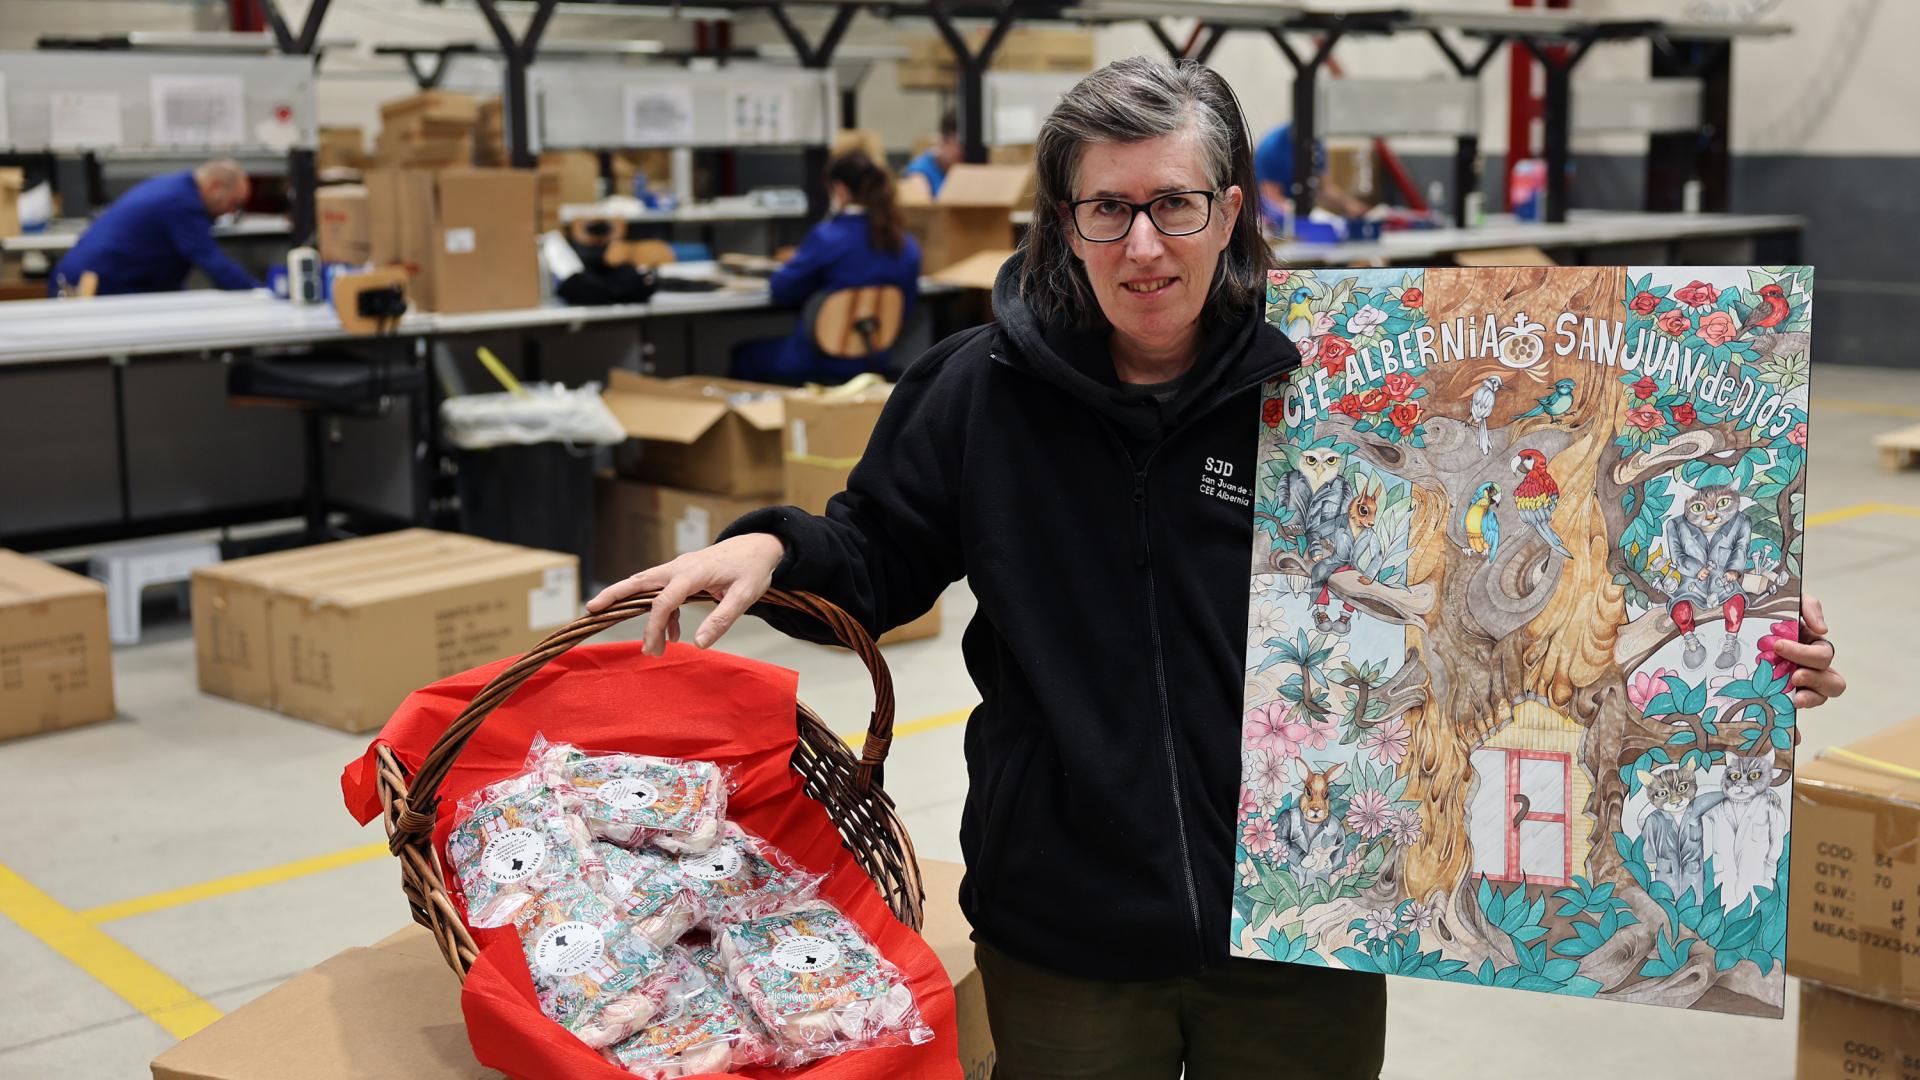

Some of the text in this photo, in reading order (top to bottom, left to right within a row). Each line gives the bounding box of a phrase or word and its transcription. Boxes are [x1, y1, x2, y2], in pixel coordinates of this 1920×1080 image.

[1283, 367, 1331, 428] CEE
[1699, 360, 1736, 408] de
[1731, 377, 1797, 438] DIOS
[1205, 457, 1234, 477] SJD
[1201, 474, 1216, 486] San
[1217, 478, 1237, 491] Juan
[1237, 485, 1248, 495] de
[1199, 484, 1216, 496] CEE
[1216, 490, 1250, 507] Albernia
[610, 972, 627, 985] SJD
